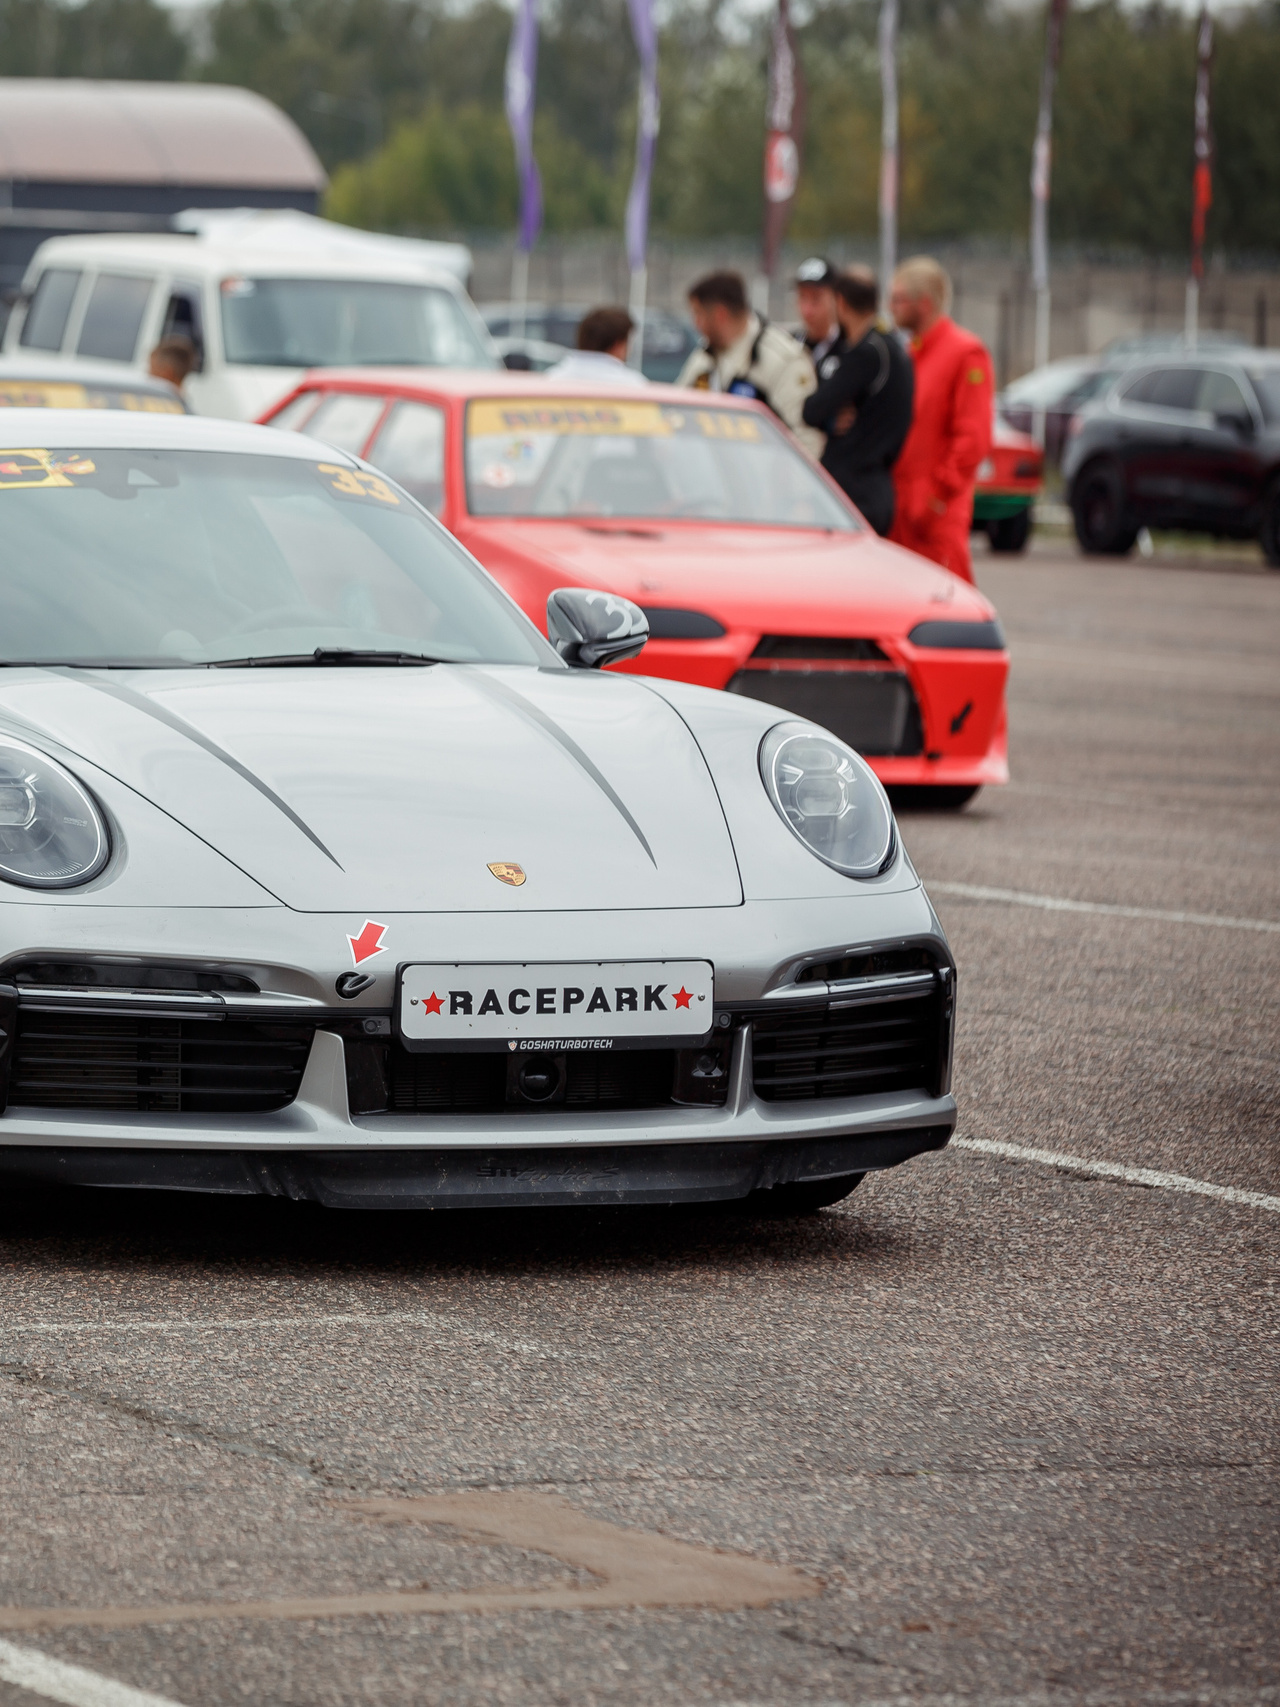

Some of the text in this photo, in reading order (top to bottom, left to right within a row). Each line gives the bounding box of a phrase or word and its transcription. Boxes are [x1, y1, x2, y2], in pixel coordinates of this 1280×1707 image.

[318, 462, 401, 505] 33
[448, 984, 668, 1016] RACEPARK
[518, 1038, 614, 1051] GOSHATURBOTECH
